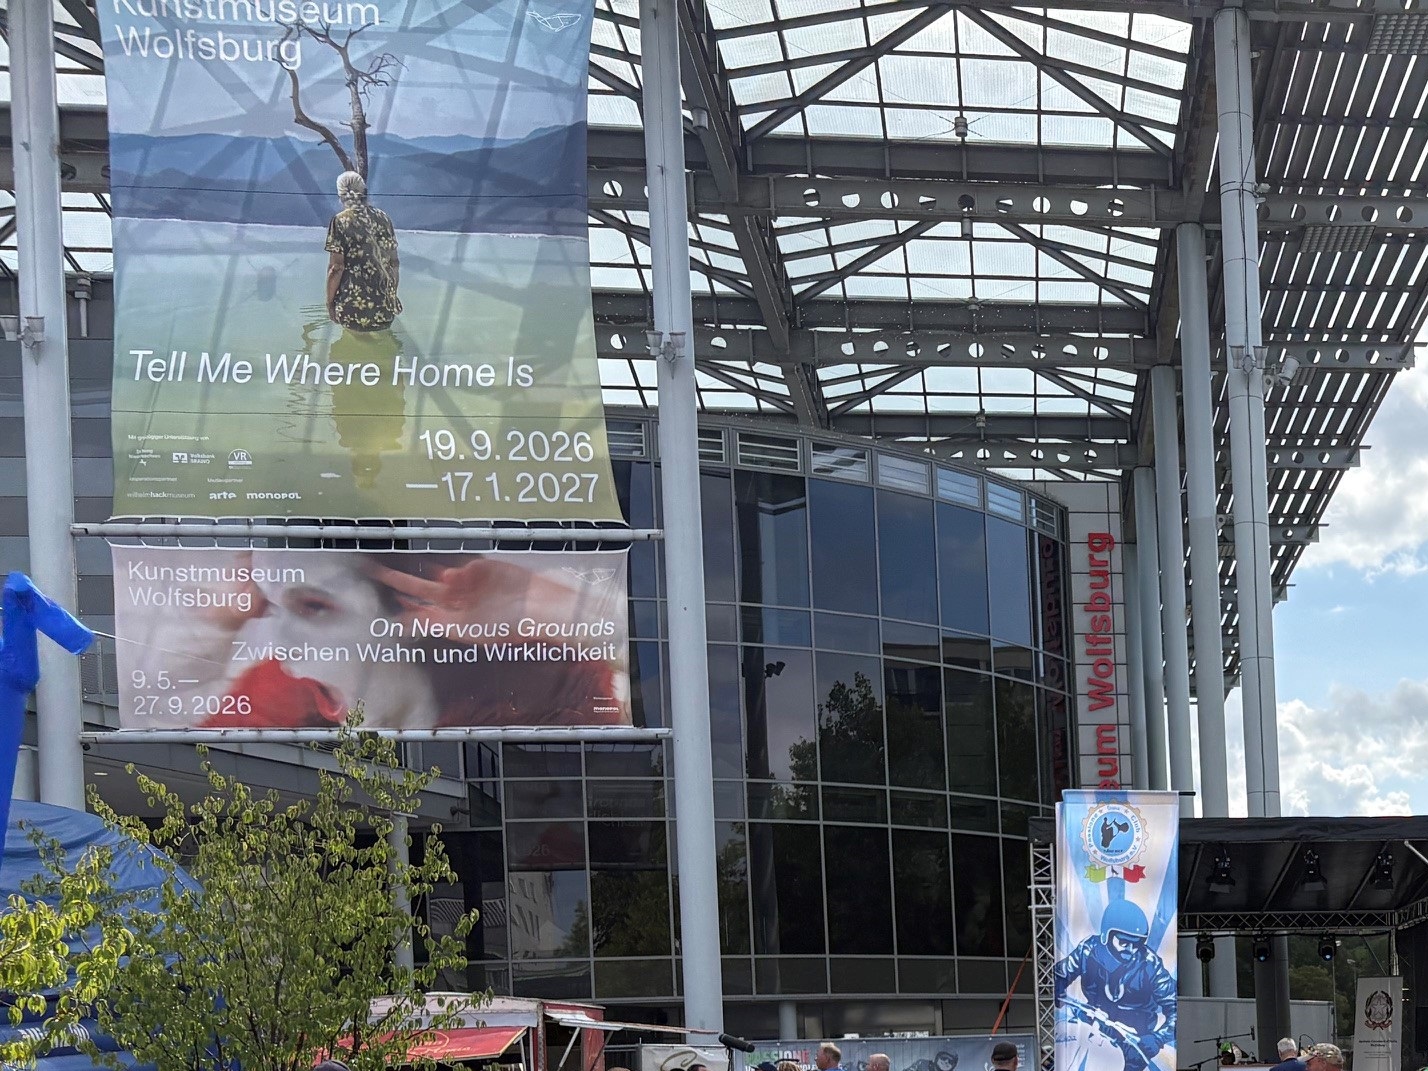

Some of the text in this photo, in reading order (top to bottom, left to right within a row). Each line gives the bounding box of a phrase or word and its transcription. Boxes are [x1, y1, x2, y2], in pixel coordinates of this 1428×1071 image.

[115, 24, 302, 70] Wolfsburg
[129, 350, 534, 387] Tell Me Where Home Is
[233, 452, 247, 461] VR
[209, 491, 237, 500] arte
[128, 561, 305, 583] Kunstmuseum
[128, 586, 252, 612] Wolfsburg
[370, 618, 615, 638] On Nervous Grounds
[1084, 532, 1115, 712] Wolfsburg
[231, 641, 616, 664] Zwischen Wahn und Wirklichkeit
[1130, 815, 1142, 833] Club
